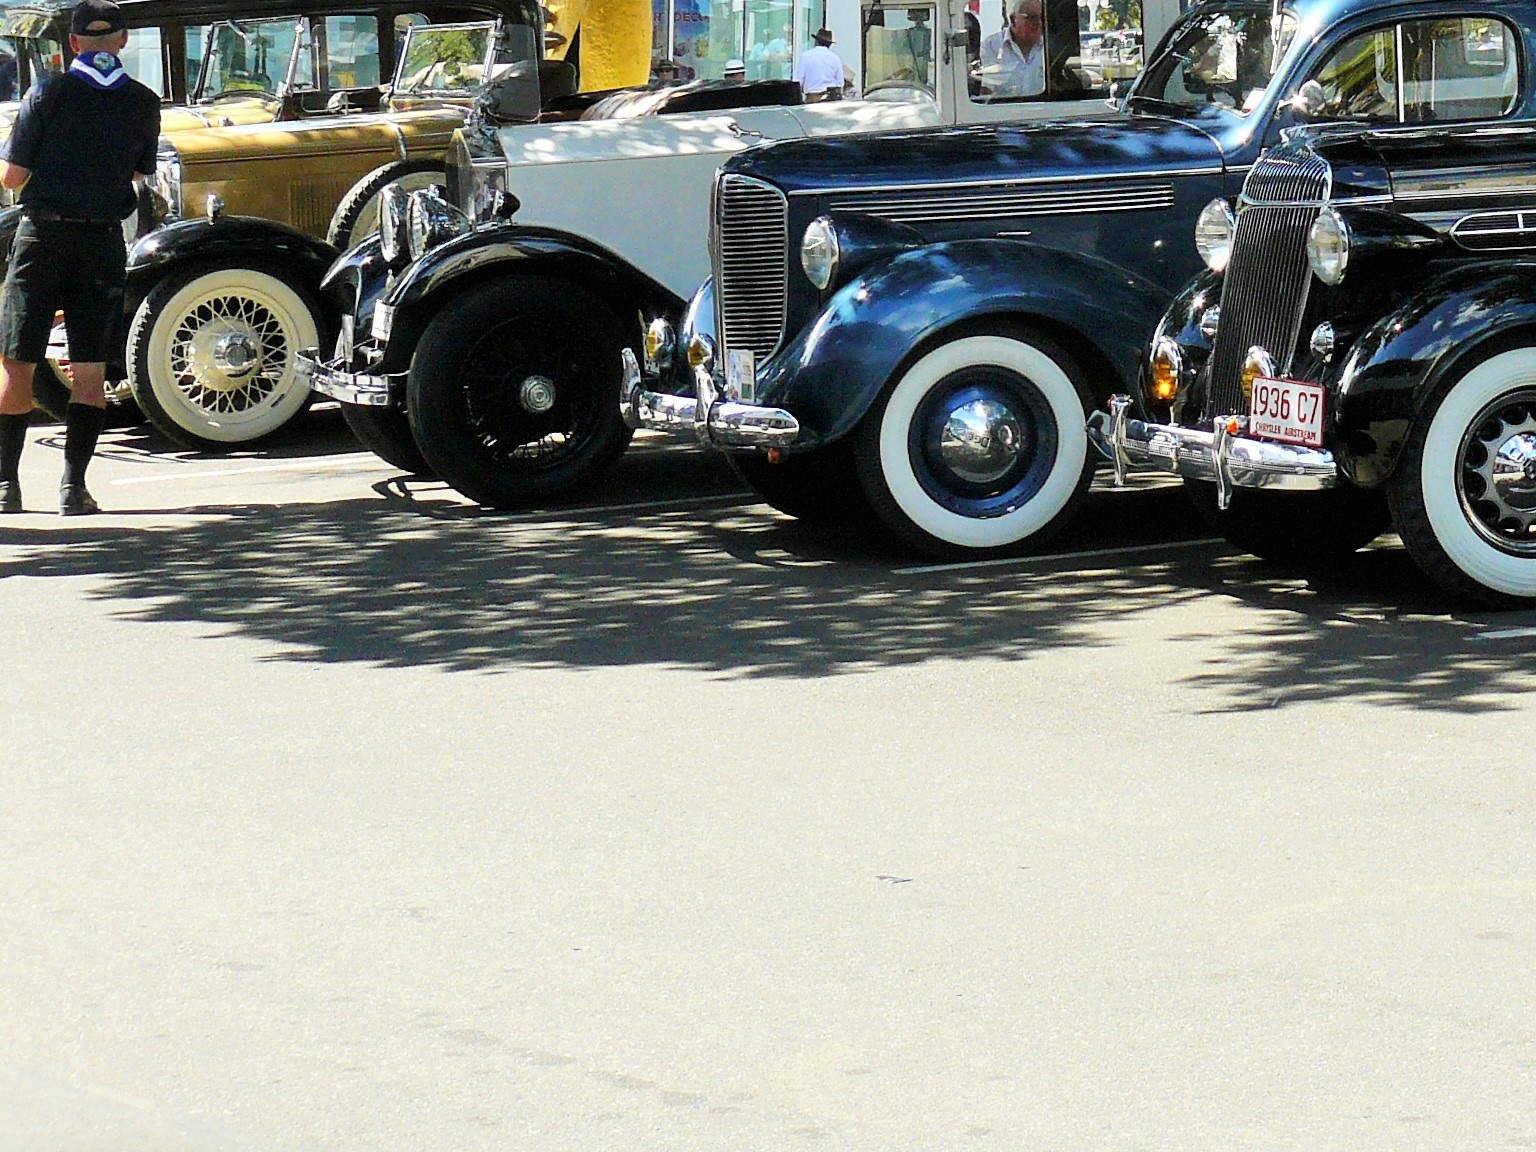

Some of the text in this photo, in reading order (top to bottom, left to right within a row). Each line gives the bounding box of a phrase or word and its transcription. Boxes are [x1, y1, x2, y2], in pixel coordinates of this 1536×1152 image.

[1252, 384, 1319, 424] 1936 C7
[1255, 421, 1317, 441] CHRYSLER AIRSTREAM
